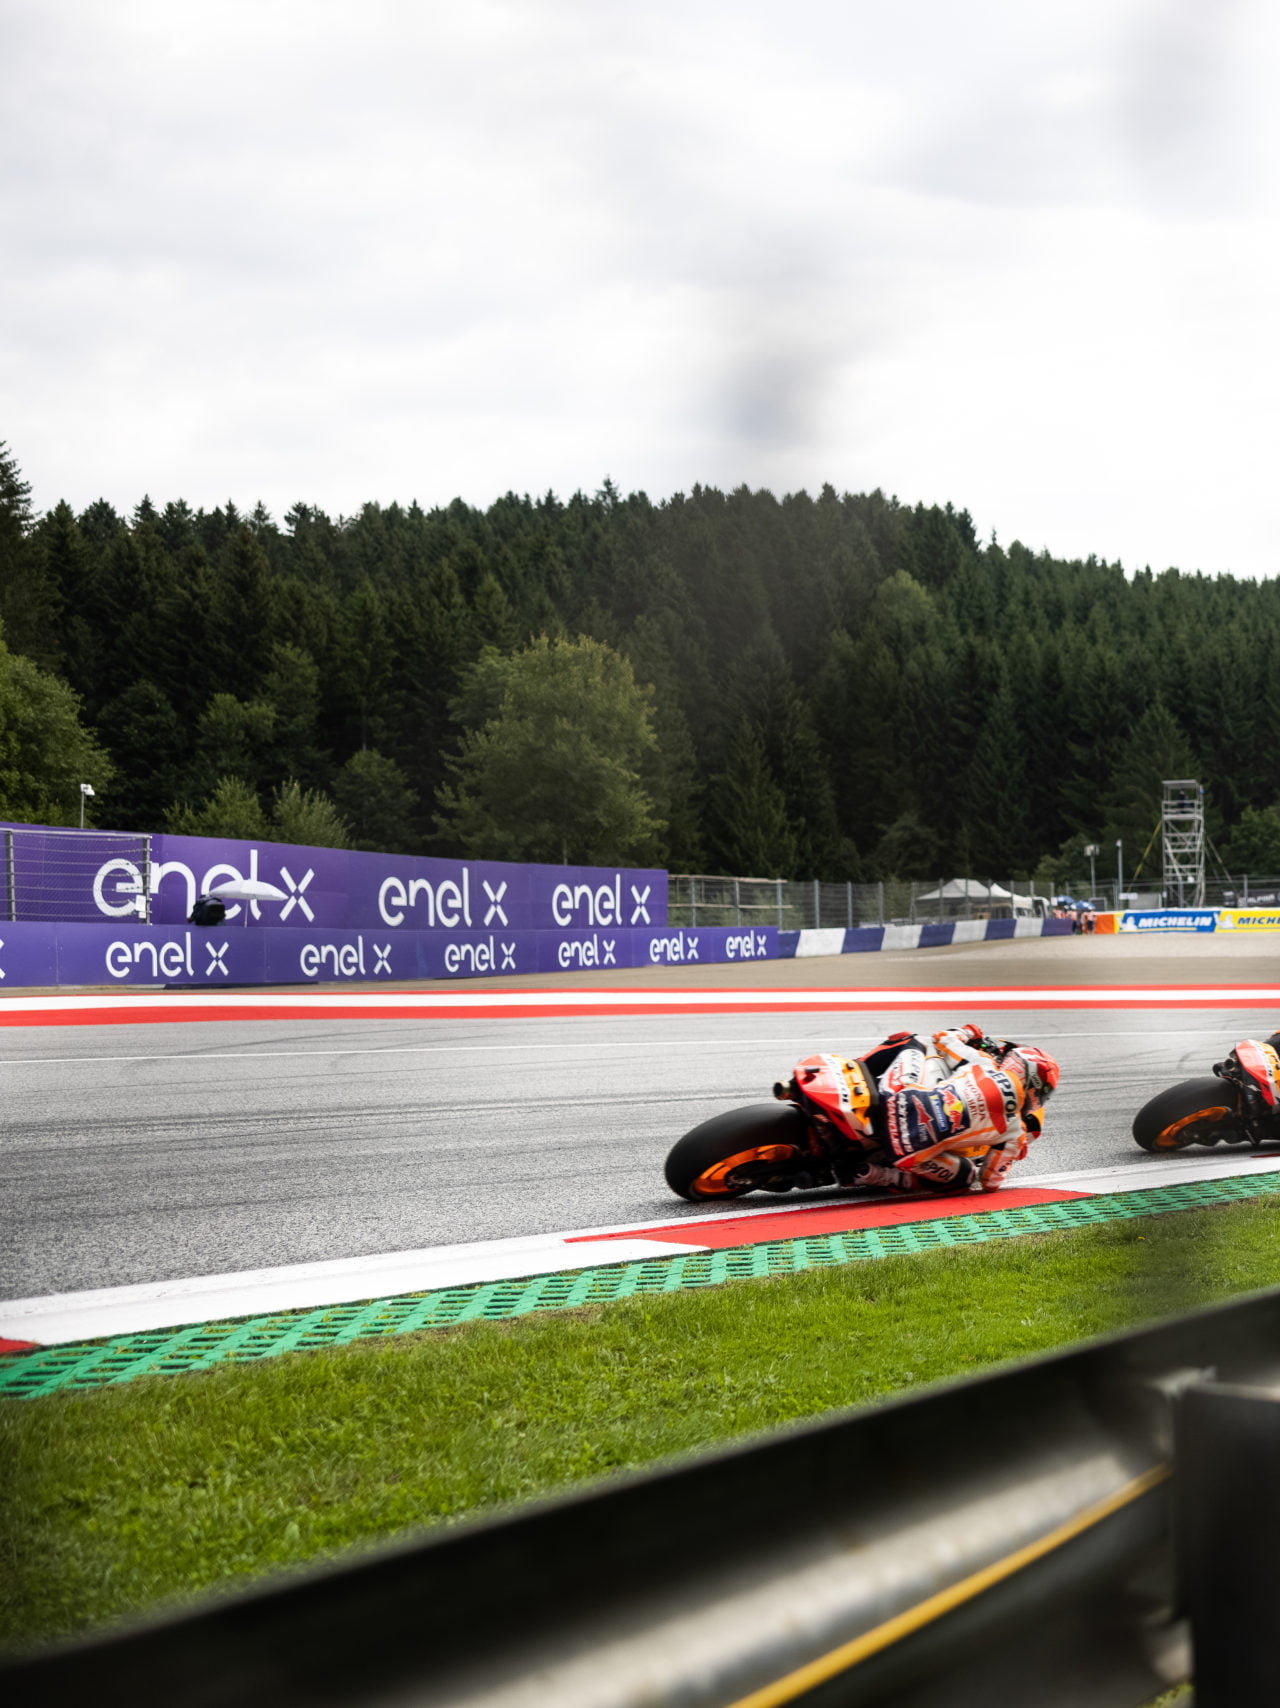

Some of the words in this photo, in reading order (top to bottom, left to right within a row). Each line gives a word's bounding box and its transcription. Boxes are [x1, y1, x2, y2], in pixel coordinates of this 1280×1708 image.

[93, 849, 262, 921] enel
[379, 867, 472, 927] enel
[552, 874, 622, 926] enel
[1138, 916, 1212, 928] MICHELIN
[106, 932, 194, 978] enel
[300, 935, 366, 976] enel
[445, 936, 495, 972] enel
[558, 933, 599, 967] enel
[650, 931, 684, 963] enel
[726, 930, 755, 958] enel
